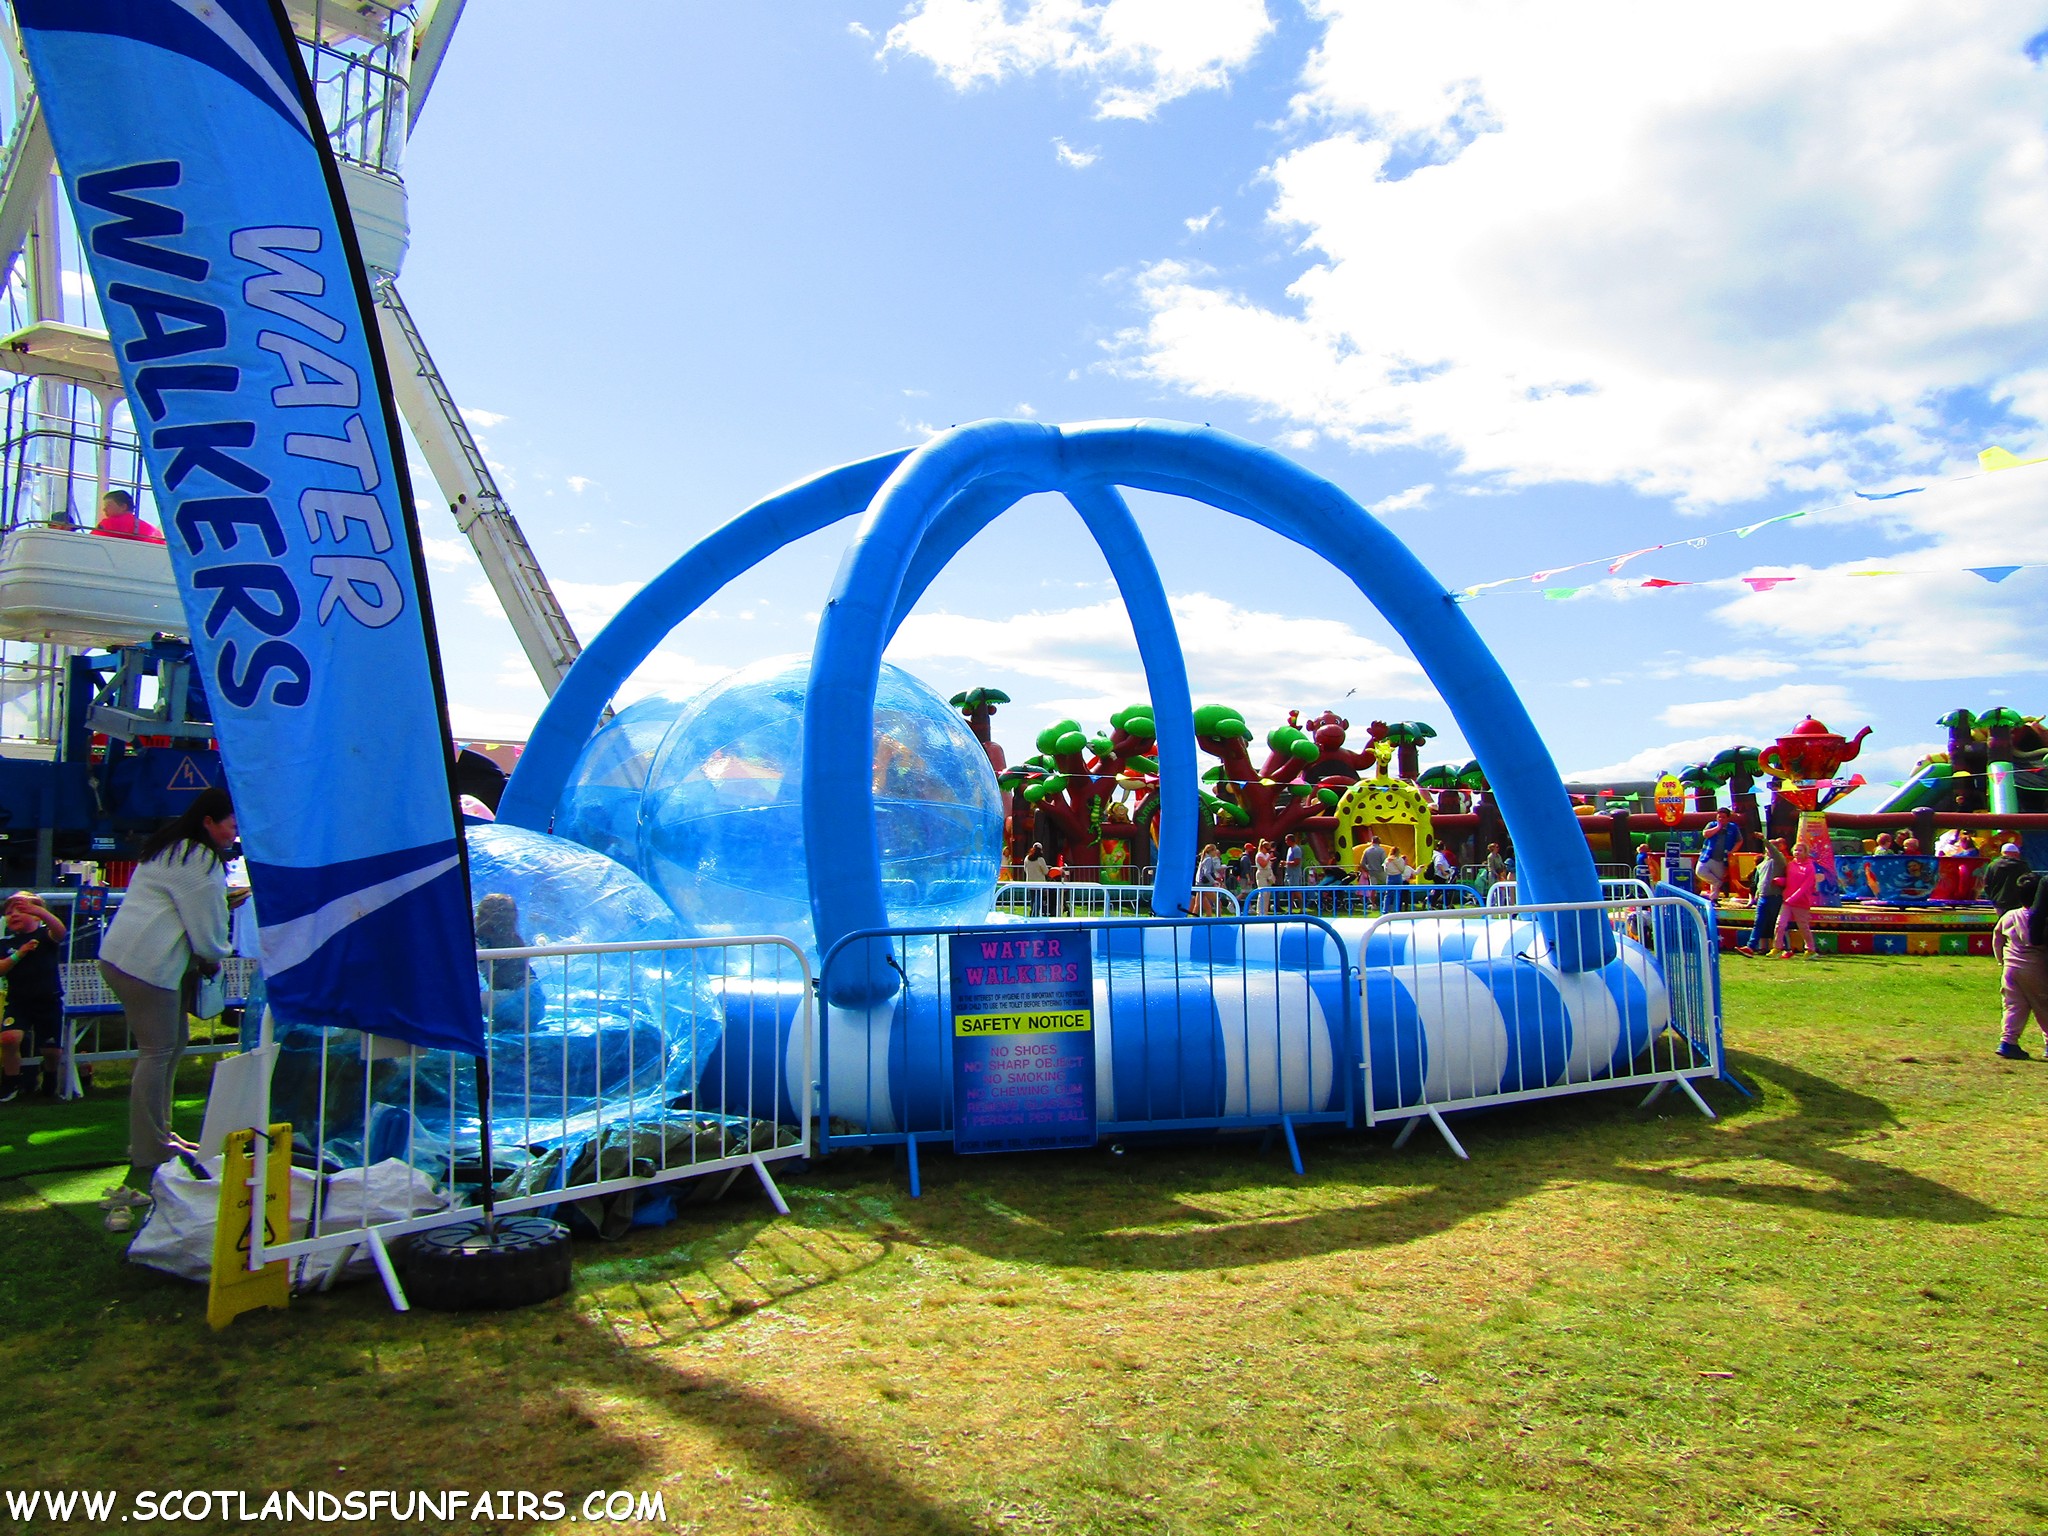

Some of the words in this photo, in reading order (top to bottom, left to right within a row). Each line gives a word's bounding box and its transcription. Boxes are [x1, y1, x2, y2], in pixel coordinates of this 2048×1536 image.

[77, 159, 311, 709] WALKERS
[229, 225, 404, 629] WATER
[981, 939, 1062, 960] WATER
[965, 963, 1079, 986] WALKERS
[974, 994, 994, 1002] INTEREST
[1002, 993, 1019, 1001] HYGIENE
[1024, 1000, 1041, 1008] BEFORE
[1042, 999, 1062, 1007] ENTERING
[962, 1017, 1021, 1032] SAFETY
[1028, 1014, 1084, 1029] NOTICE
[990, 1047, 1009, 1057] NO
[1015, 1044, 1057, 1056] SHOES
[964, 1061, 982, 1072] NO
[989, 1059, 1031, 1071] SHARP
[1035, 1056, 1084, 1069] OBJECT
[983, 1074, 1002, 1084] NO
[1007, 1071, 1066, 1083] SMOKING
[967, 1088, 986, 1099] NO
[991, 1085, 1050, 1097] CHEWING
[237, 1193, 277, 1209] CAON
